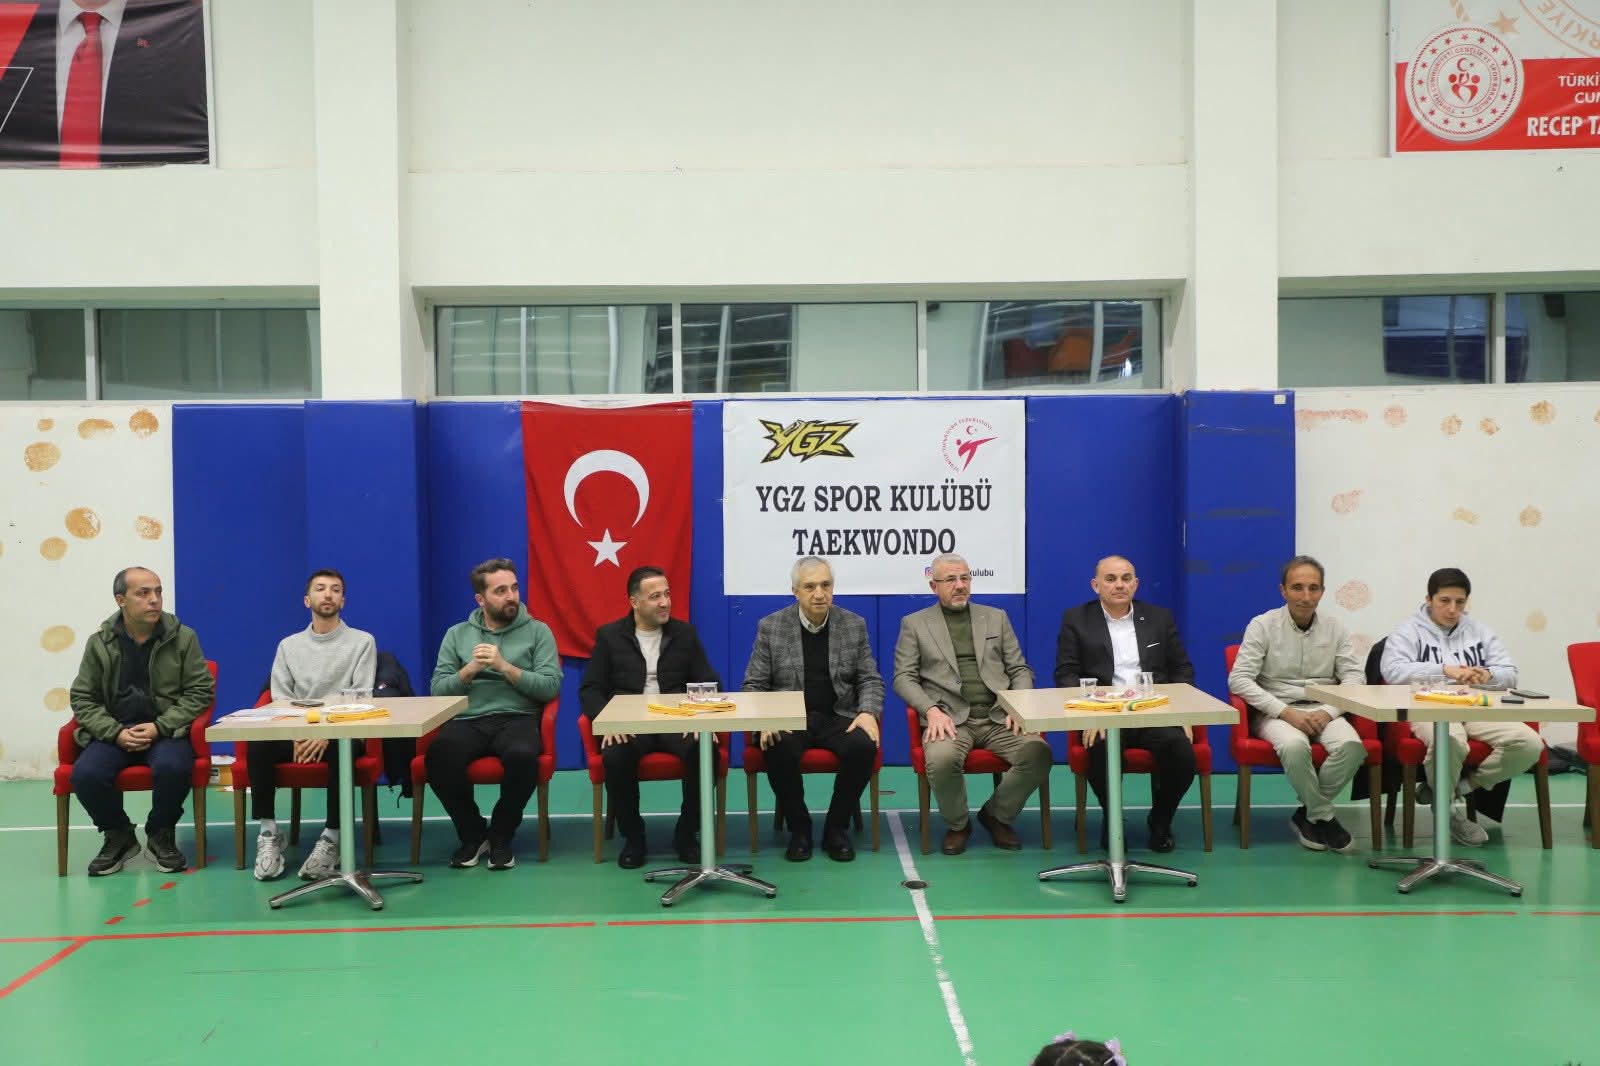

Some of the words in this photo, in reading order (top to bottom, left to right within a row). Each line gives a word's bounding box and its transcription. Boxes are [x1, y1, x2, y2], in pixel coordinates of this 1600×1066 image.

[1526, 115, 1583, 137] RECEP
[759, 418, 860, 464] YGZ
[756, 485, 805, 512] YGZ
[814, 485, 882, 512] SPOR
[890, 478, 992, 511] KULÜBÜ
[792, 529, 956, 556] TAEKWONDO
